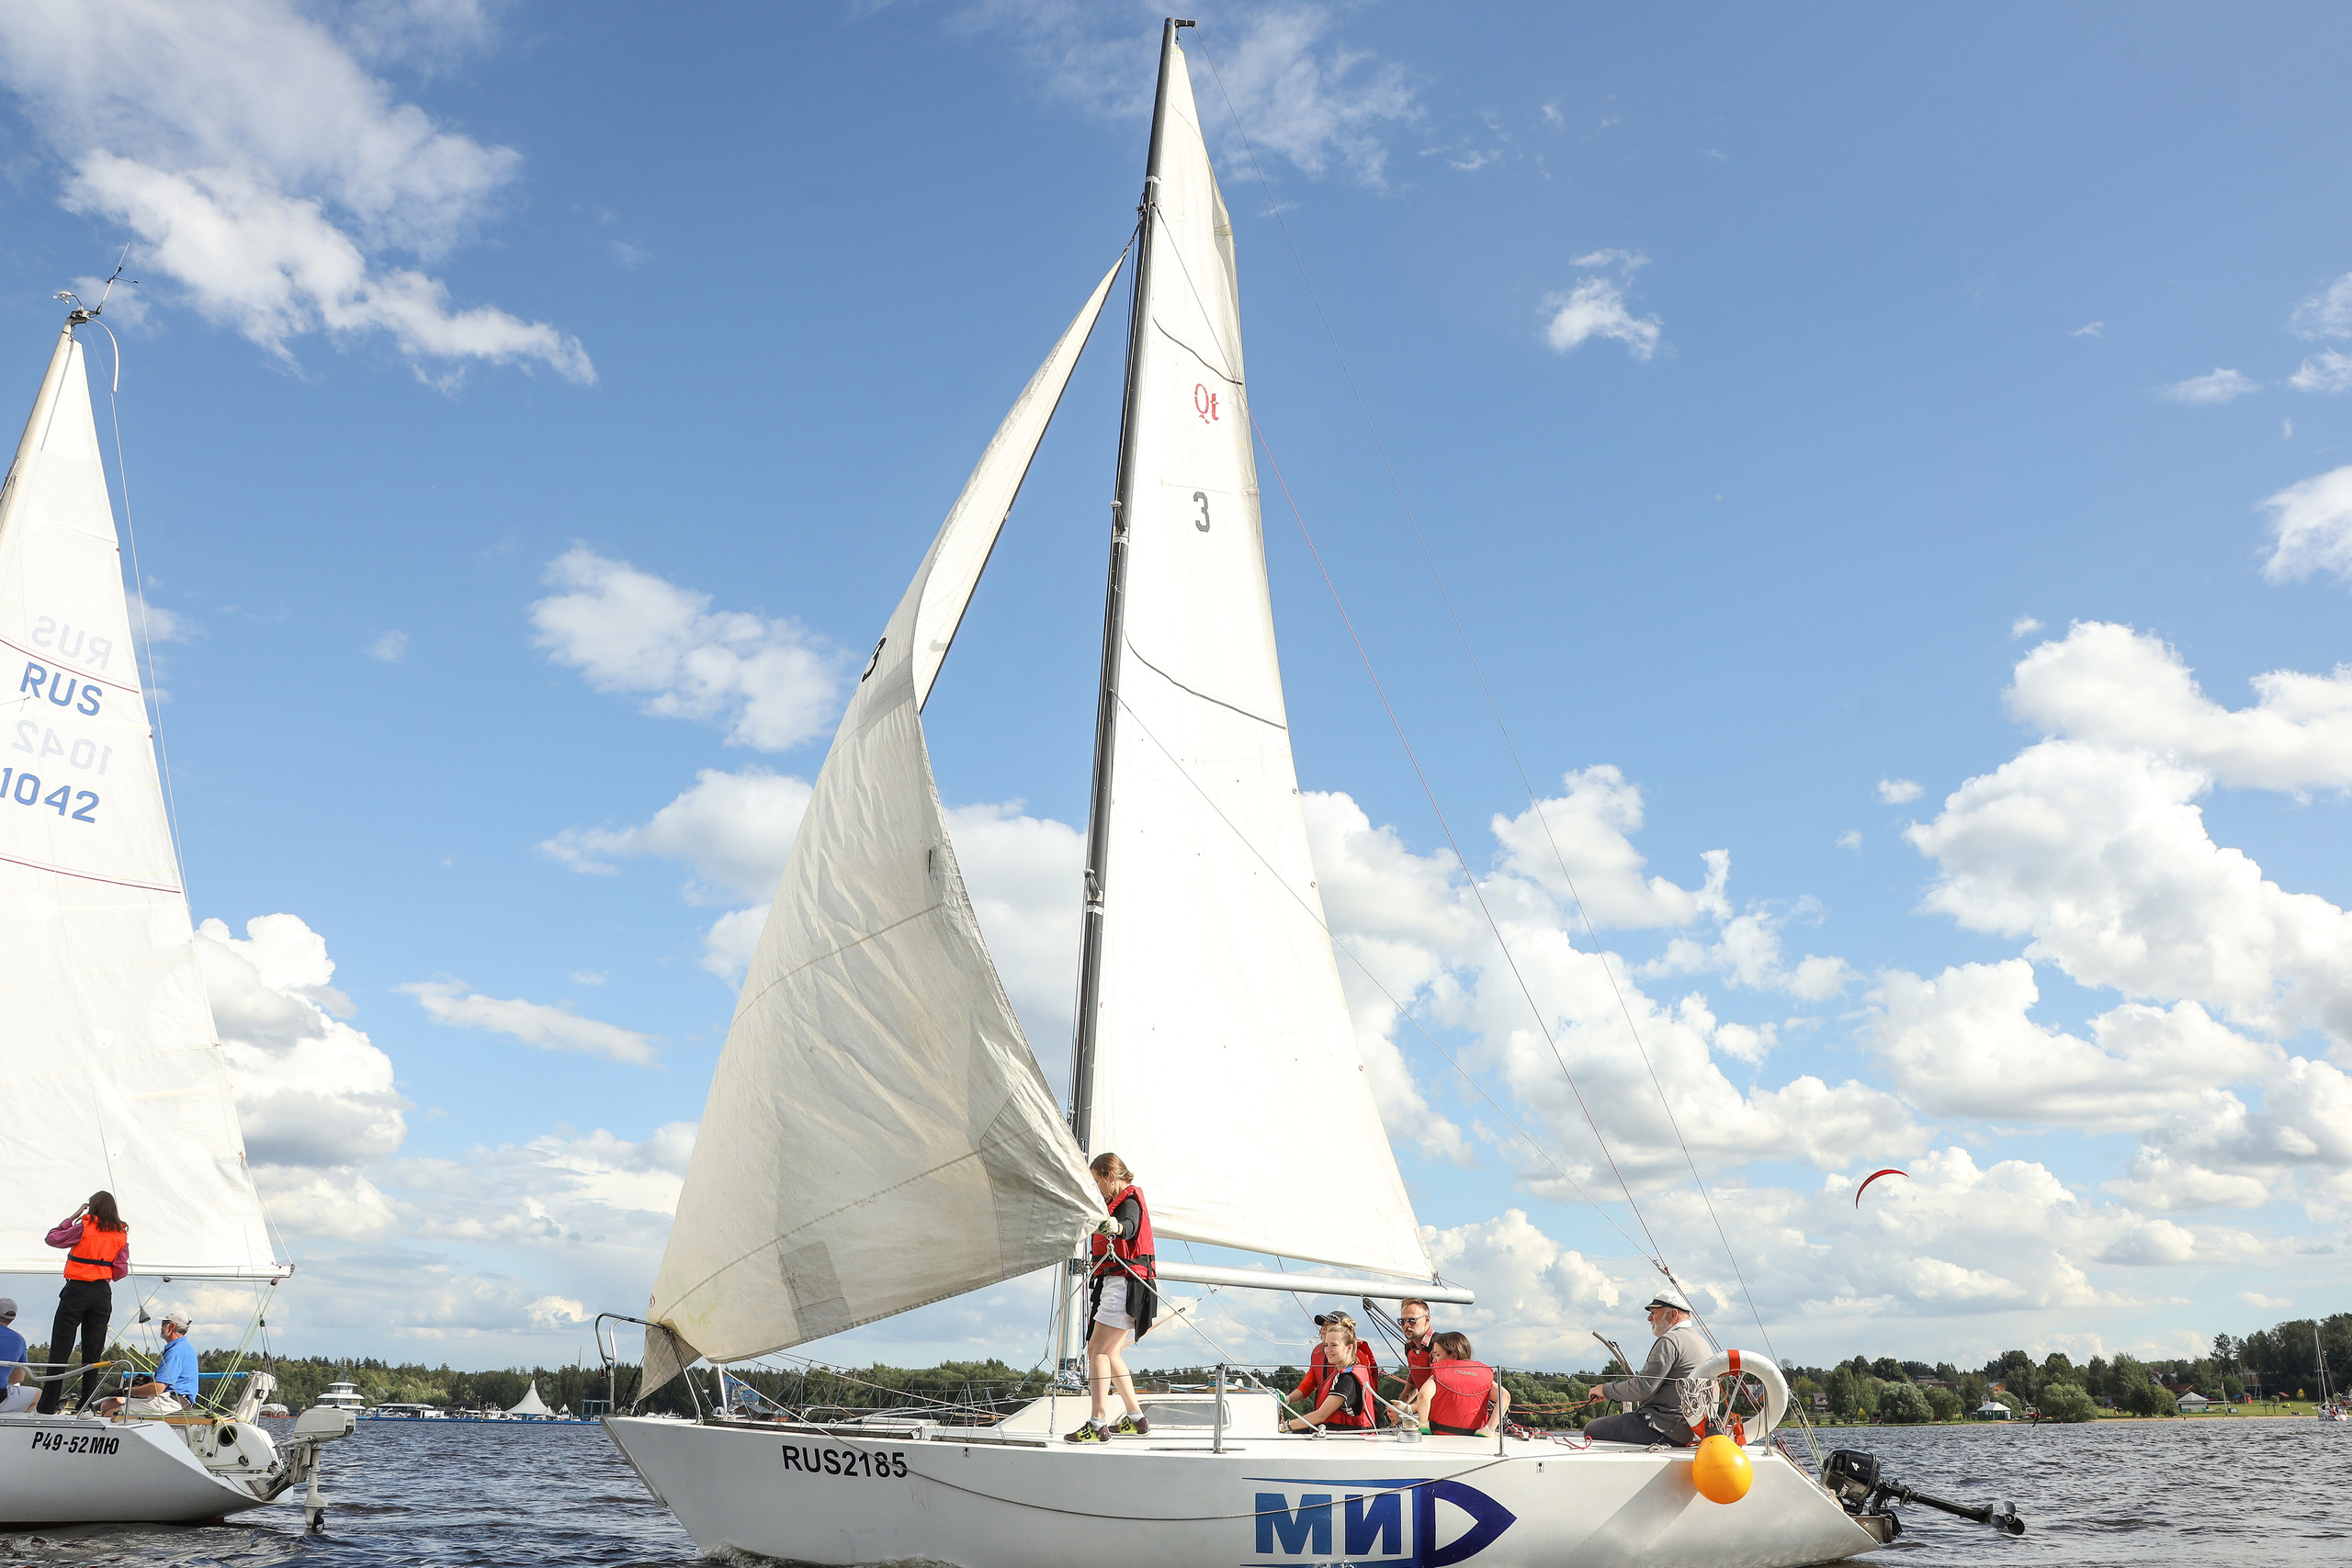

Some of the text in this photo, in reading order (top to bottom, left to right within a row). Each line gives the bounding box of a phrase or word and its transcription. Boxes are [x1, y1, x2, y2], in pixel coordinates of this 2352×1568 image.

[1193, 491, 1210, 532] 3
[19, 661, 102, 716] RUS
[0, 767, 99, 823] 1042
[782, 1445, 908, 1478] RUS2185
